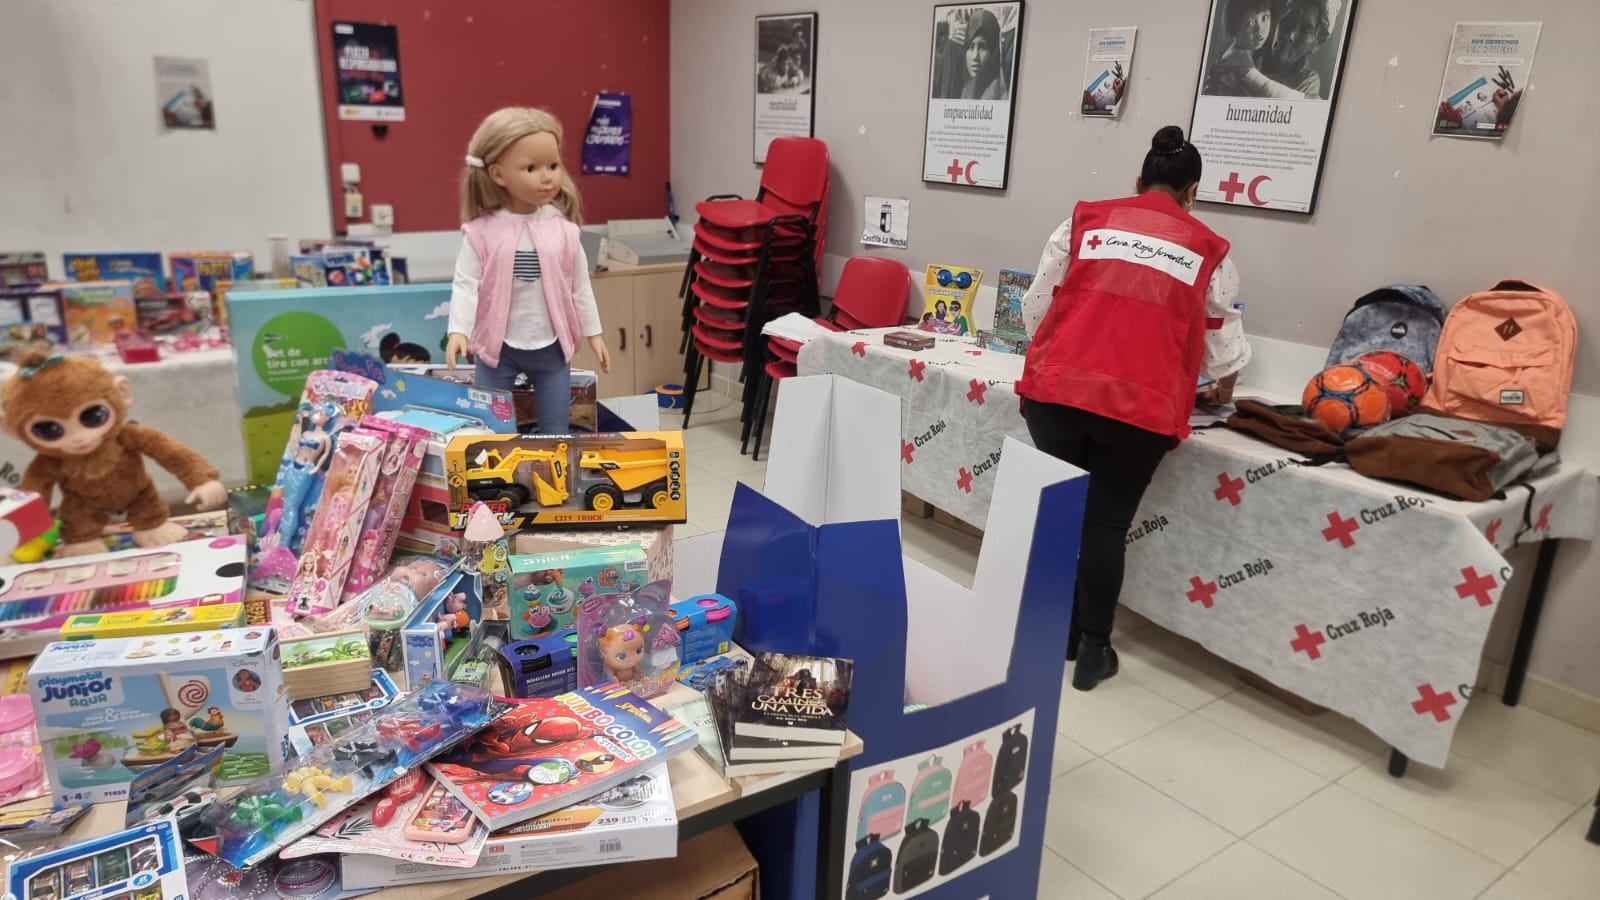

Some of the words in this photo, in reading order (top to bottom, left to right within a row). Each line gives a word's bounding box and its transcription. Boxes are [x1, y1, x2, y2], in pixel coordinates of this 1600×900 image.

[944, 104, 993, 122] imparcialidad
[1226, 104, 1293, 124] humanidad
[1106, 236, 1130, 246] Cruz
[1131, 239, 1154, 254] Roja
[1137, 247, 1194, 269] Juventud
[914, 431, 932, 447] Cruz
[929, 419, 946, 436] Roja
[972, 459, 992, 476] Cruz
[1245, 462, 1276, 484] Cruz
[1360, 502, 1397, 525] Cruz
[1142, 514, 1169, 534] Roja
[1217, 568, 1245, 589] Cruz
[1243, 557, 1274, 578] Roja
[1325, 619, 1362, 640] Cruz
[1358, 606, 1395, 628] Roja
[38, 671, 103, 688] playmobil
[771, 685, 824, 699] TRES
[751, 701, 789, 713] UNA
[793, 704, 834, 717] VIDA
[554, 692, 615, 726] JUMBO
[603, 724, 656, 760] COLOR
[597, 817, 618, 825] 239
